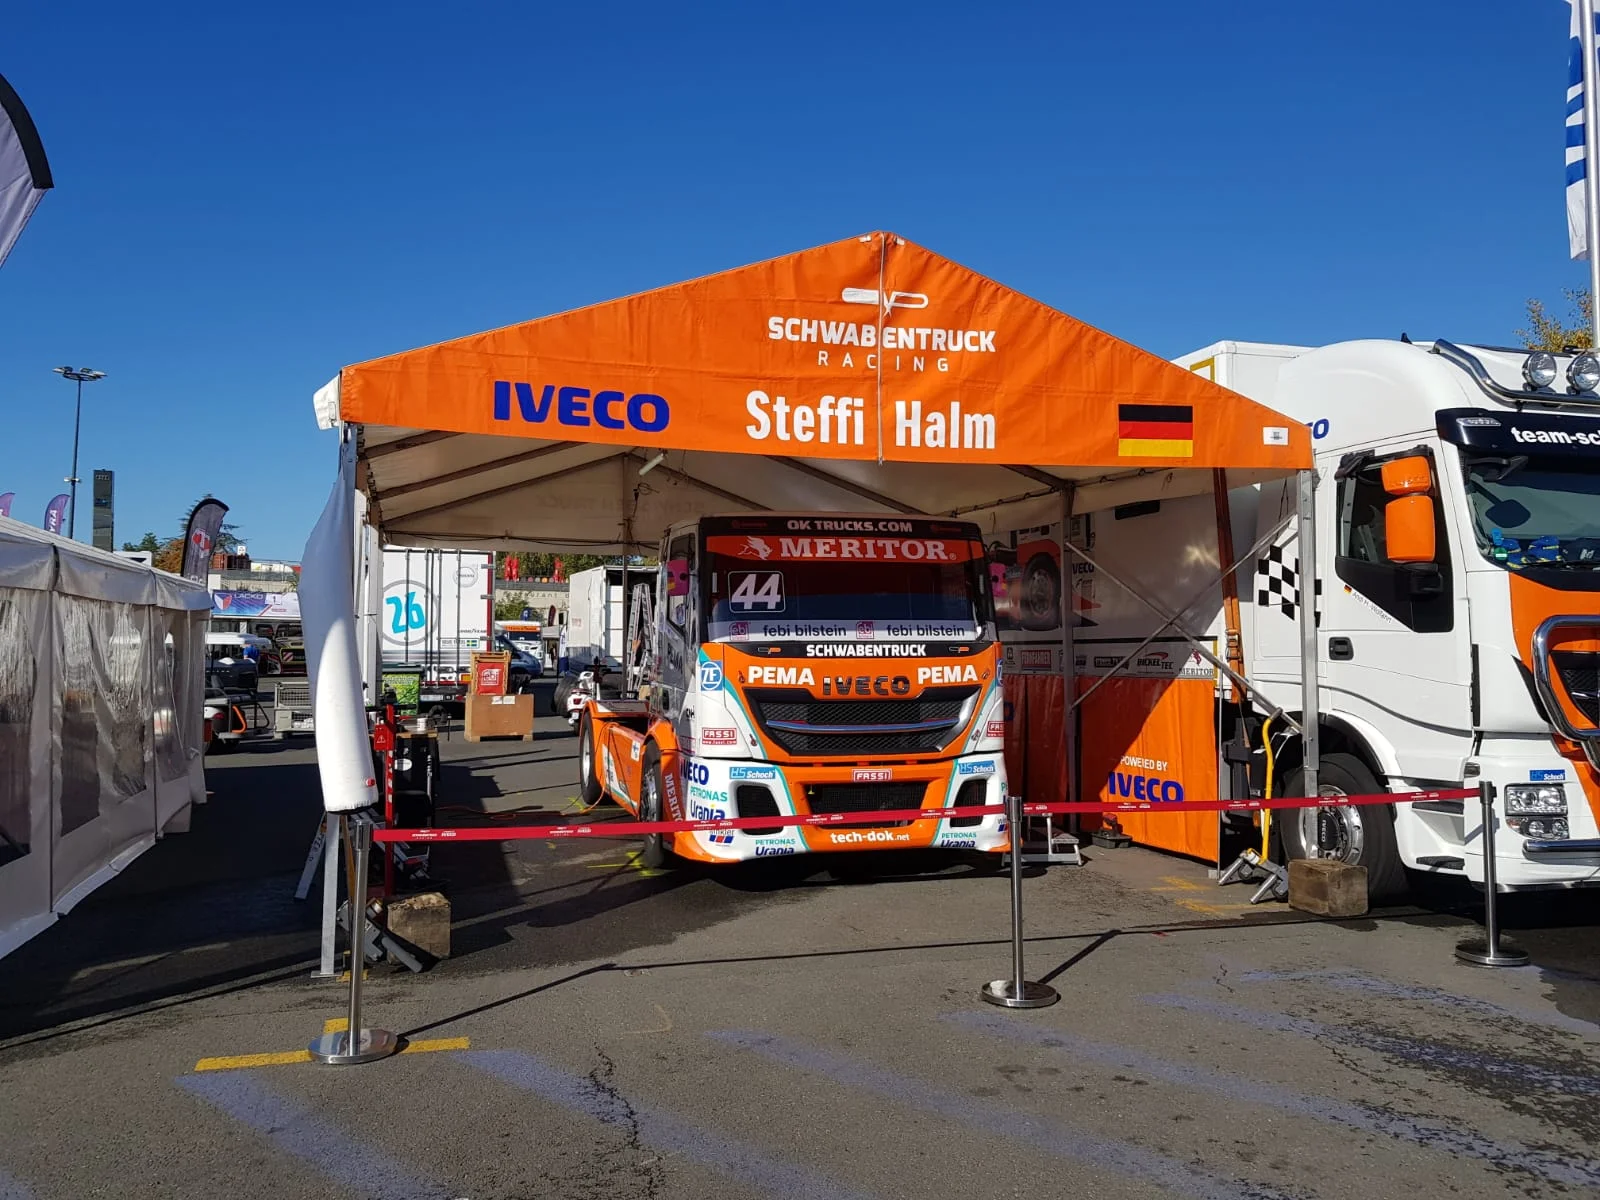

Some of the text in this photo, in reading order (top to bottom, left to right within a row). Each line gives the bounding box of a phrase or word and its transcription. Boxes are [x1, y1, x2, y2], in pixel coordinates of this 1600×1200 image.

[768, 316, 996, 352] SCHWABENTRUCK
[818, 351, 949, 372] RACING
[494, 380, 670, 432] IVECO
[746, 390, 996, 449] Steffi Halm
[1511, 427, 1600, 445] team-sc
[816, 520, 913, 533] TRUCKS.COM
[778, 537, 948, 560] MERITOR
[1072, 562, 1094, 574] VECO
[731, 573, 782, 610] 44
[385, 591, 426, 634] 26
[763, 623, 792, 637] febi
[794, 623, 847, 637] bilstein
[886, 623, 913, 637] febi
[916, 623, 965, 637] bilstein
[806, 643, 926, 657] SCHWABENTRUCK
[701, 668, 718, 682] ZF
[748, 665, 815, 686] PEMA
[917, 664, 978, 685] PEMA
[822, 675, 910, 696] IVECO
[704, 730, 734, 738] FASSI
[1120, 755, 1168, 772] POWERED BY
[746, 770, 775, 780] Schoch
[856, 772, 888, 780] FASSI
[690, 785, 728, 802] PETRONAS
[1109, 771, 1185, 802] IVECO
[665, 772, 684, 821] MERITO
[690, 799, 726, 820] Urania
[755, 838, 796, 846] PETRONAS
[830, 830, 910, 843] tech-dok.net
[940, 838, 976, 848] Urania
[941, 831, 977, 839] PETRONAS
[755, 845, 795, 857] Urania
